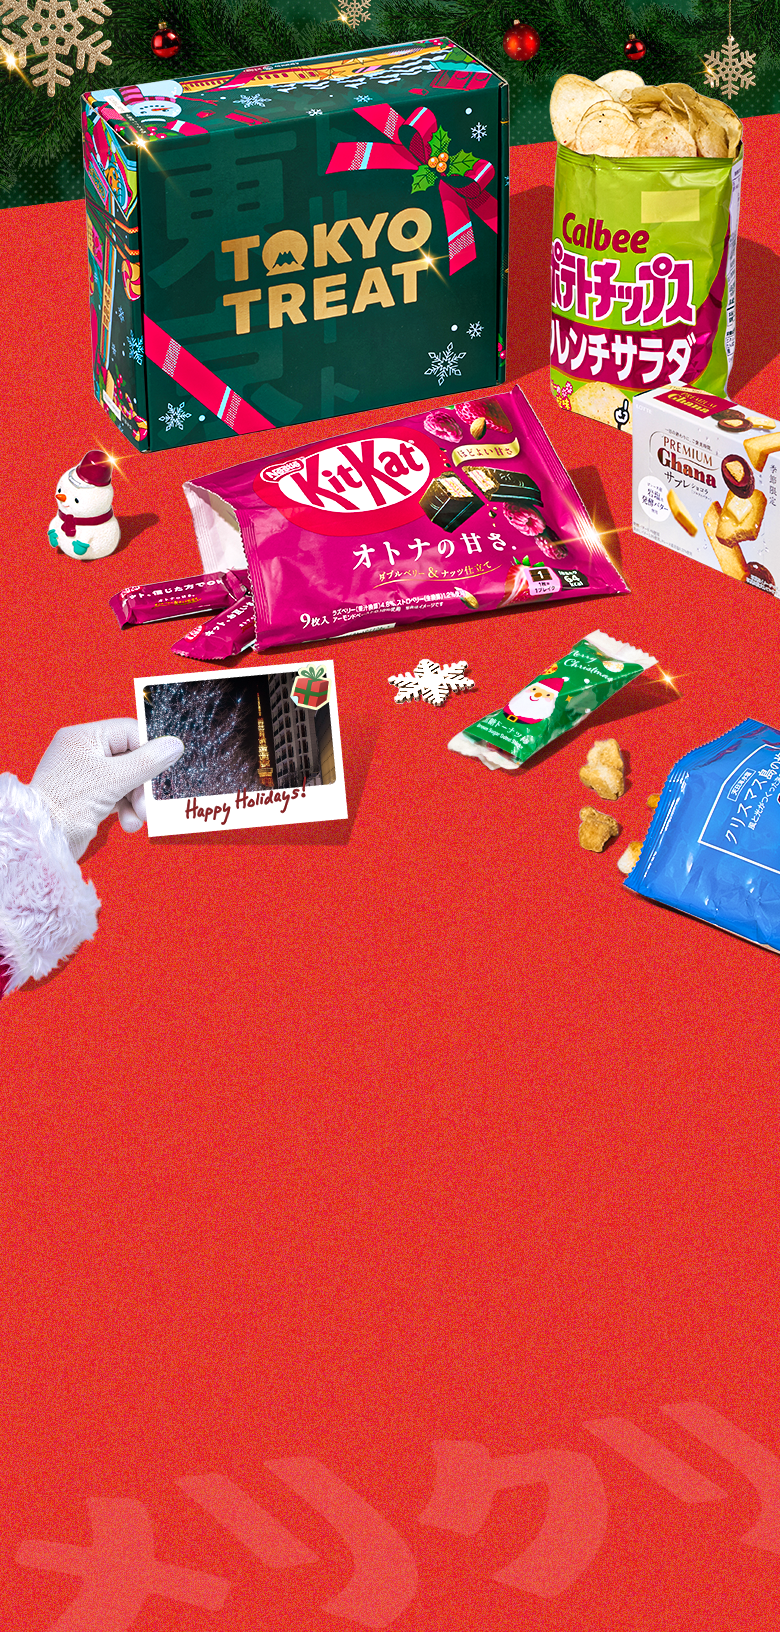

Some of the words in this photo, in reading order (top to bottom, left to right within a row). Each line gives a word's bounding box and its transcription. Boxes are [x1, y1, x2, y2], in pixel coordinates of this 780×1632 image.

[221, 207, 432, 282] TOKYO
[562, 212, 650, 254] Calbee
[222, 258, 430, 335] TREAT
[667, 393, 709, 413] Ghana
[657, 447, 717, 489] Ghana
[663, 436, 713, 467] PREMIUM
[290, 440, 424, 511] KitKat
[537, 570, 544, 579] 1
[564, 574, 581, 583] 64
[300, 612, 330, 630] 9枚入
[563, 657, 614, 683] Christmas
[184, 797, 231, 825] Happy
[235, 776, 307, 813] Holidays!
